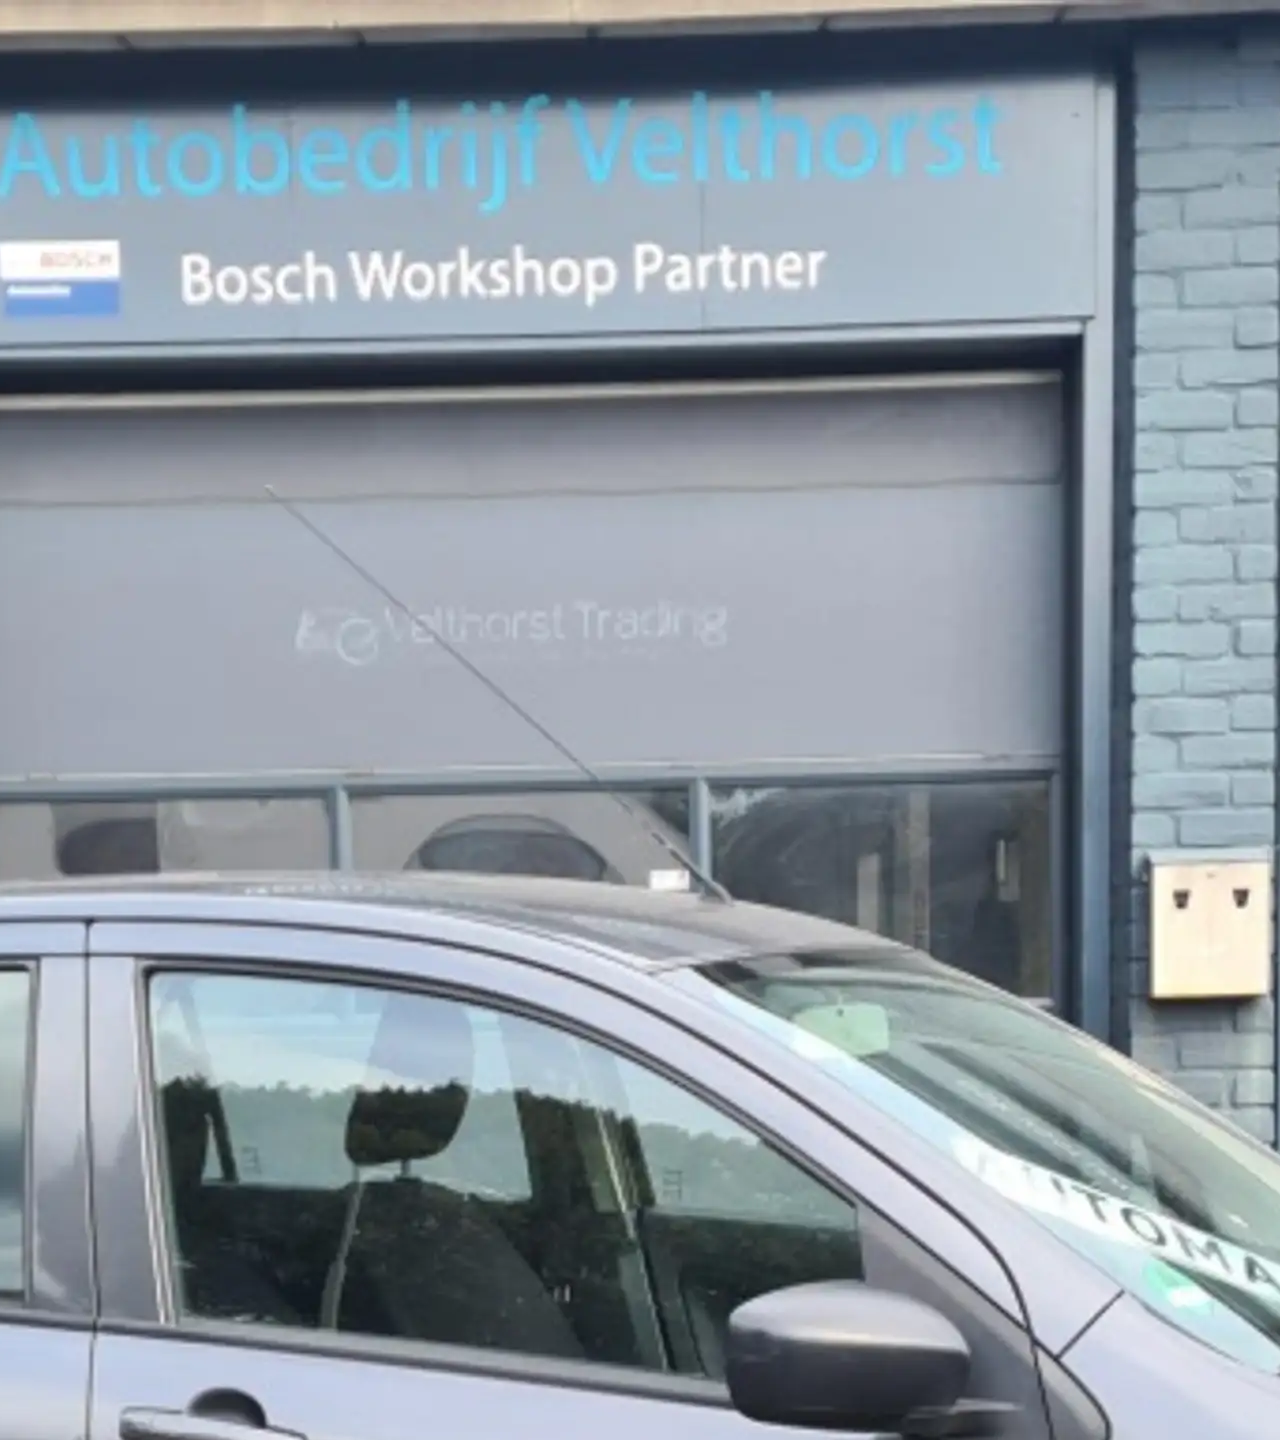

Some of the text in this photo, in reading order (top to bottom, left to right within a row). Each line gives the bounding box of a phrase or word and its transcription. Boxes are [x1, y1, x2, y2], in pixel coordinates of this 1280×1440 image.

[566, 91, 1004, 183] Velthorst
[181, 242, 828, 308] Bosch Workshop Partner
[573, 600, 729, 648] Trading
